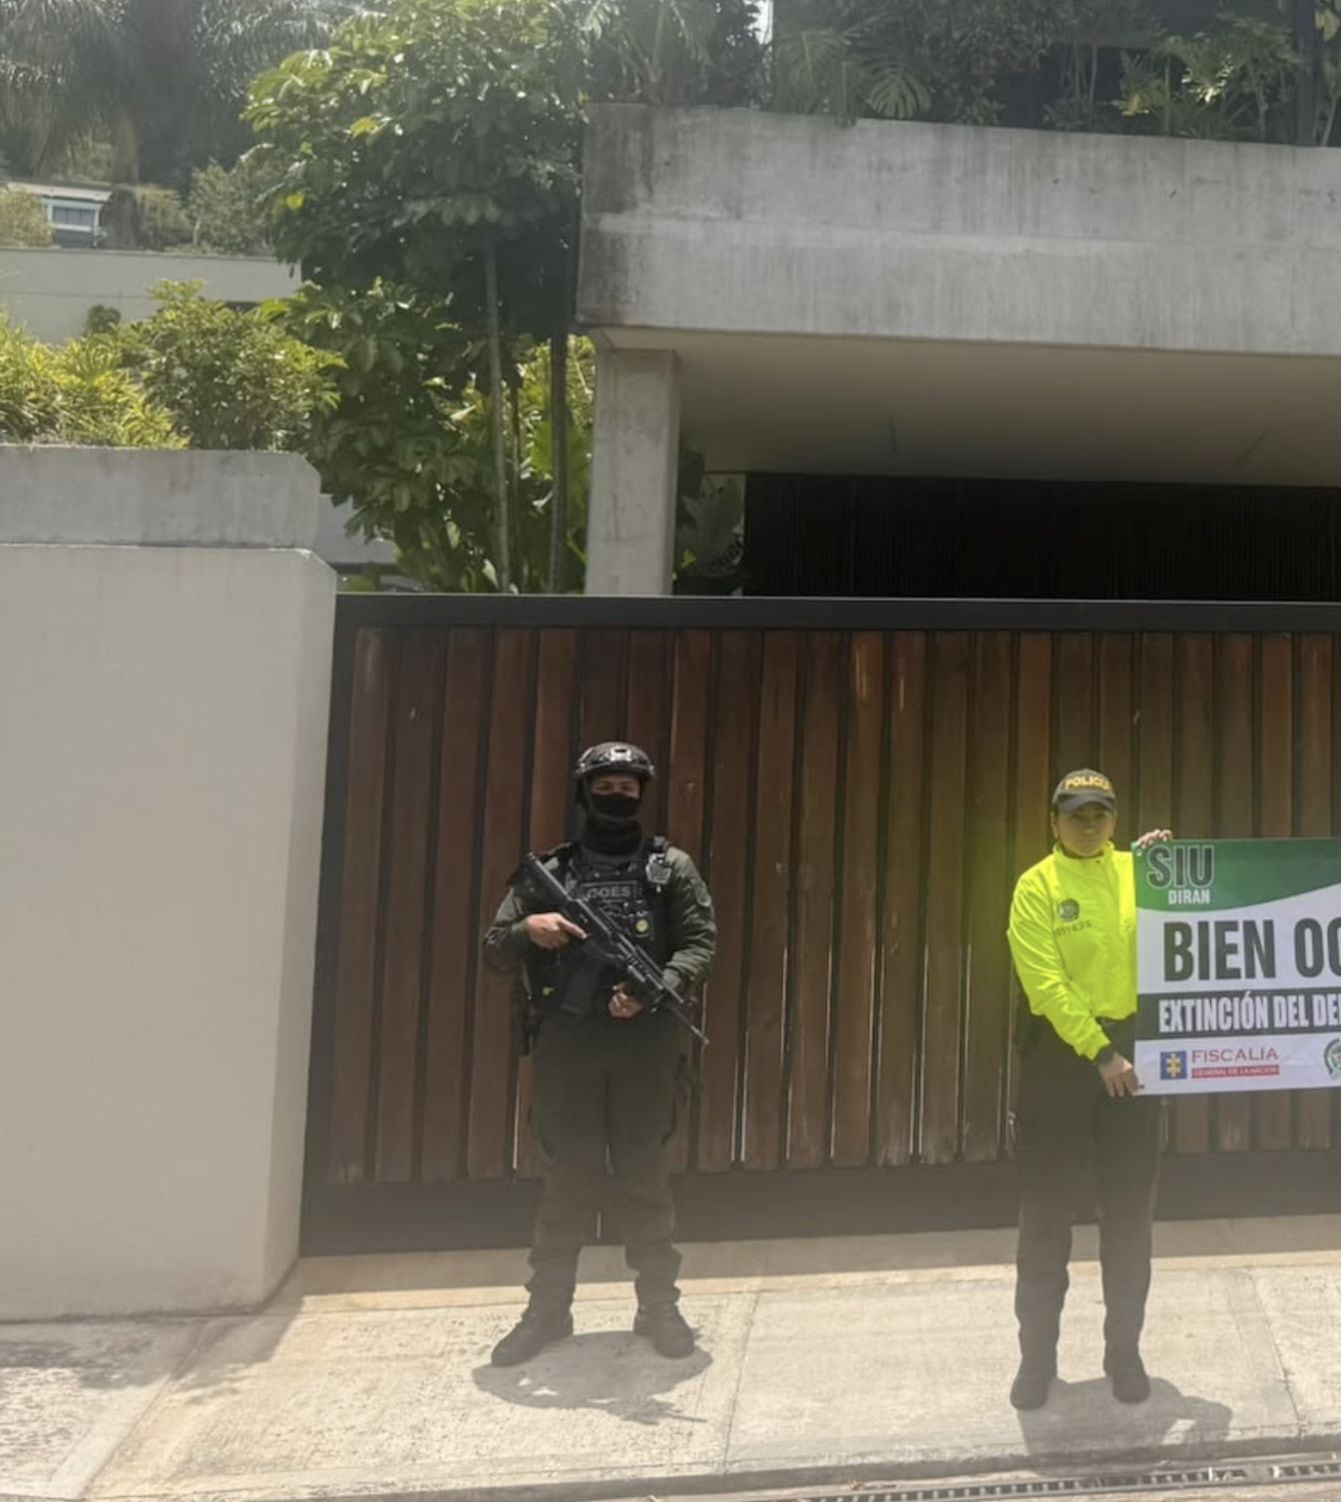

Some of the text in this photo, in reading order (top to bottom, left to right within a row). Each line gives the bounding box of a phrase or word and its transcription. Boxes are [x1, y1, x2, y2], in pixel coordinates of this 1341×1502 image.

[1146, 844, 1215, 890] SIU
[1168, 889, 1211, 904] DIRAN
[1163, 919, 1276, 981] BIEN
[1158, 990, 1269, 1033] EXTINCIÓN
[1272, 994, 1309, 1028] DEL
